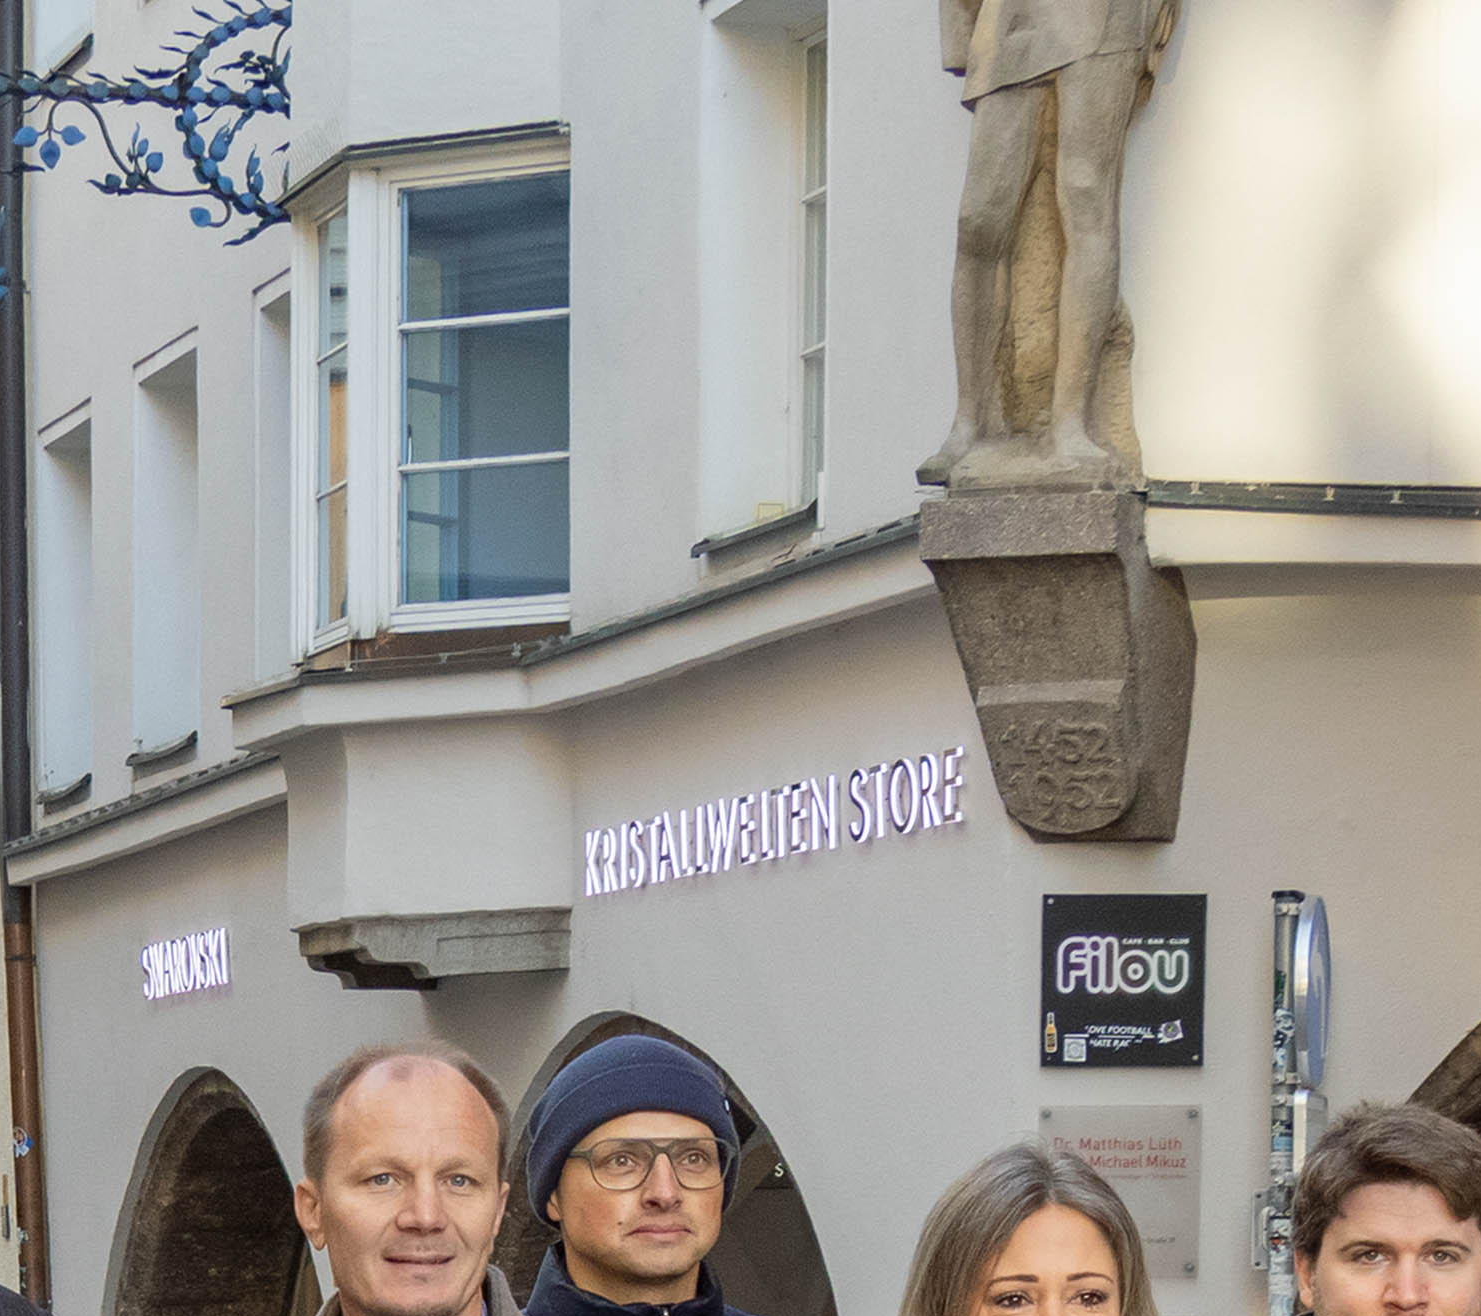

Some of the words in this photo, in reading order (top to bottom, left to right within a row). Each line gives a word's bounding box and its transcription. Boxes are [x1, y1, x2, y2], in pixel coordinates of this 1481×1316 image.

[584, 774, 837, 897] KRISTALLWELTEN
[848, 744, 966, 844] STORE
[141, 927, 230, 1001] SWAROVSKI
[1056, 935, 1189, 994] Filou
[1078, 1137, 1144, 1150] Matthias
